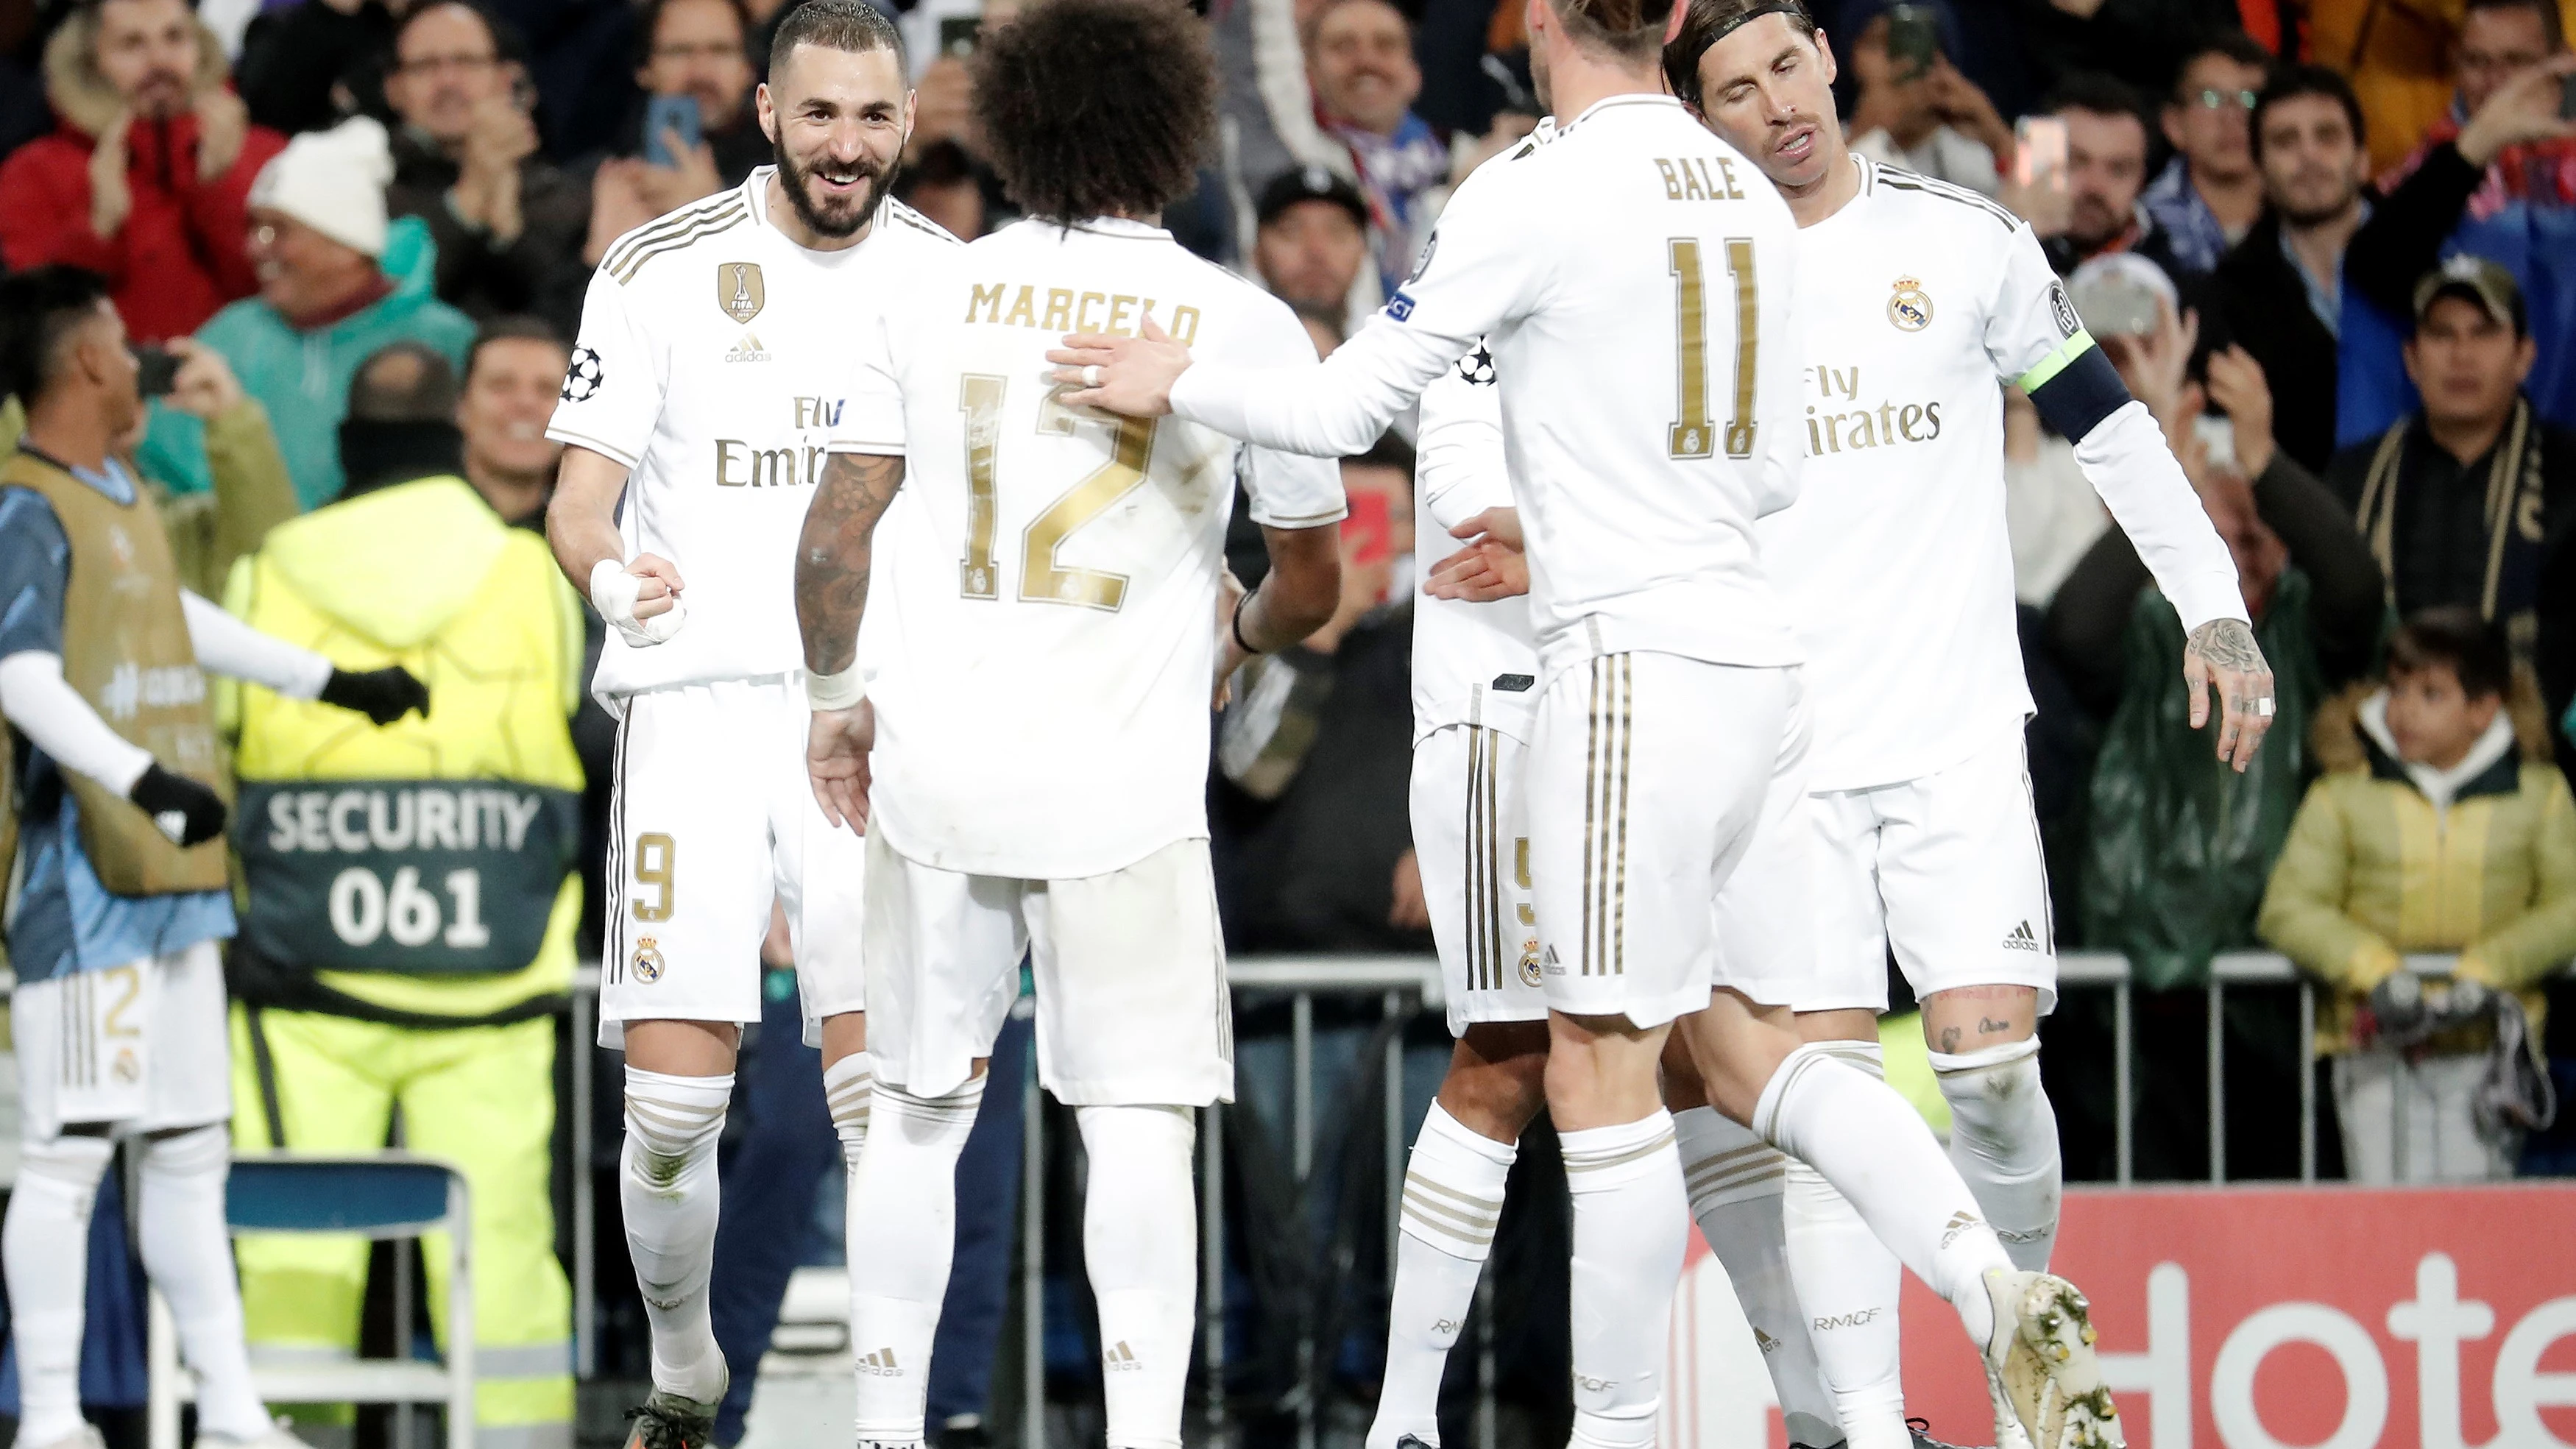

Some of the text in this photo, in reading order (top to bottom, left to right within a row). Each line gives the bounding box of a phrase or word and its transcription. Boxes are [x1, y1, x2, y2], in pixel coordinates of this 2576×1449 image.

[1653, 157, 1746, 200] BALE
[730, 300, 754, 310] FIFA
[725, 350, 771, 364] adidas
[1667, 236, 1759, 459] 11
[1804, 399, 1940, 459] irates
[959, 372, 1160, 614] 12
[267, 789, 542, 853] SECURITY
[328, 865, 491, 949] 061
[631, 832, 676, 923] 9
[2003, 938, 2039, 952] adidas
[1814, 1307, 1882, 1331] RMCF
